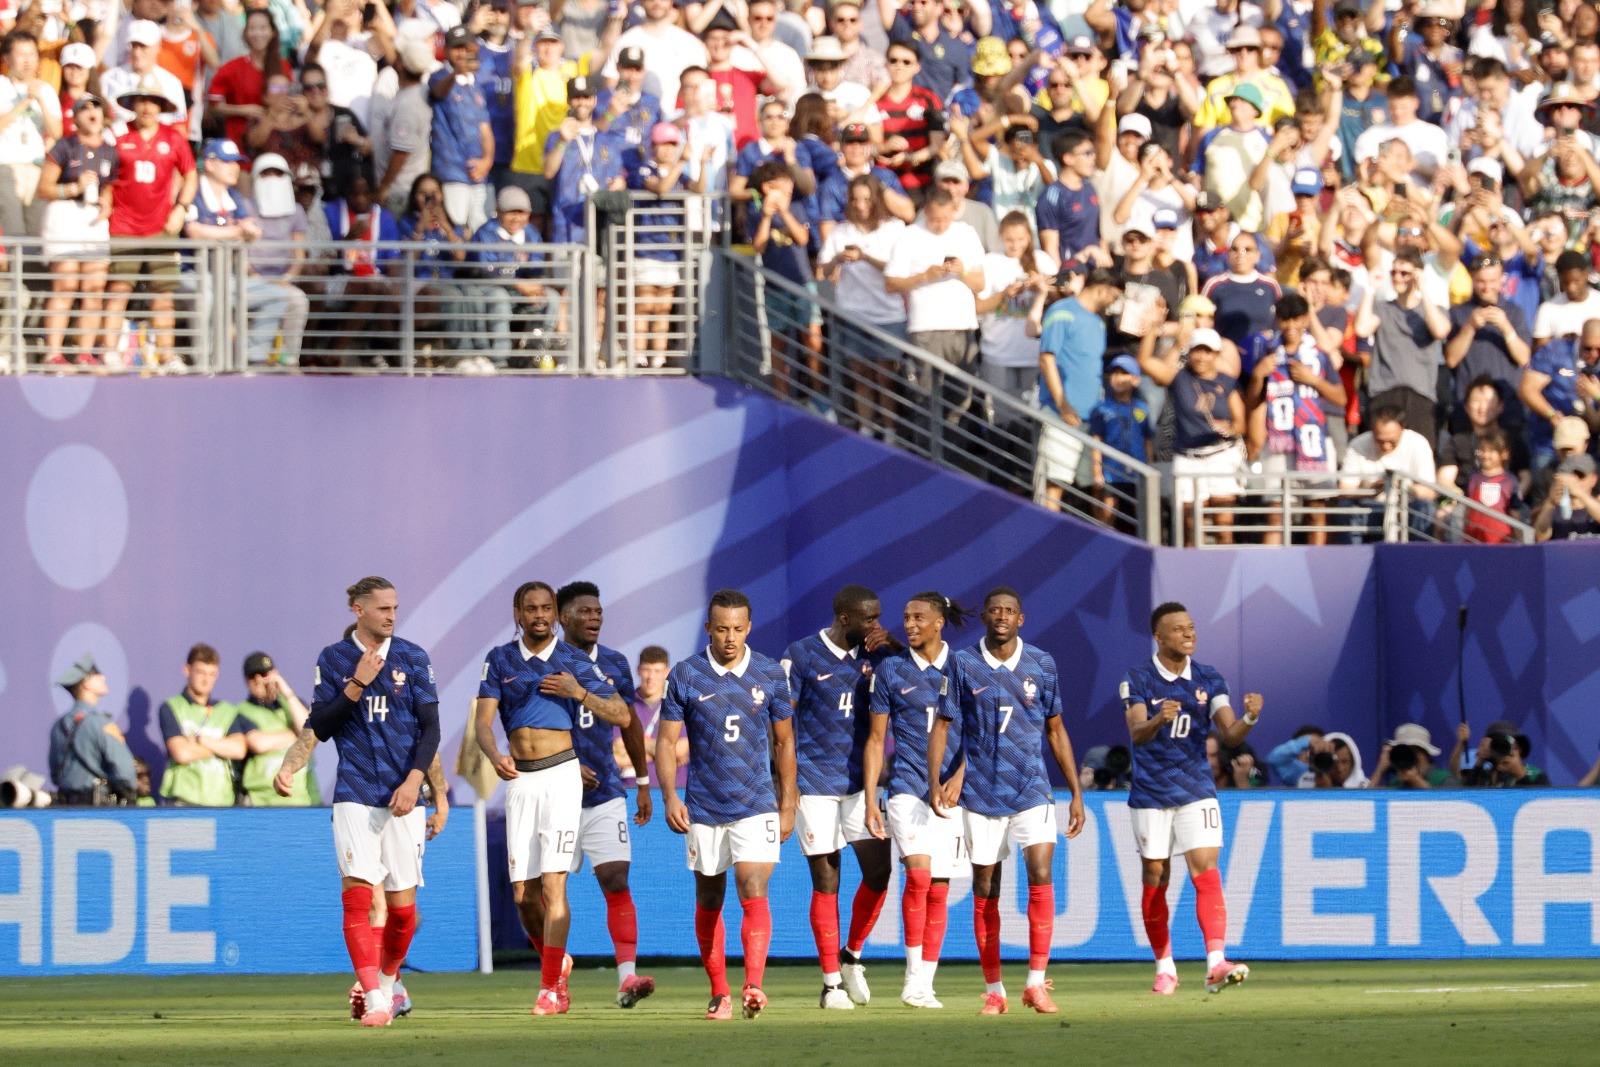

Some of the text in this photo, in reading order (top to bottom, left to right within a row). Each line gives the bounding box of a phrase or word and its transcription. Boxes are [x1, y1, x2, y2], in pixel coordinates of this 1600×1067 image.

[134, 160, 156, 183] 10
[366, 695, 389, 722] 14
[580, 704, 593, 728] 8
[839, 692, 853, 717] 4
[724, 715, 740, 742] 5
[999, 706, 1013, 733] 7
[1170, 714, 1191, 738] 10
[1201, 807, 1219, 829] 10
[556, 830, 575, 854] 12
[618, 821, 628, 843] 8
[765, 820, 776, 843] 5
